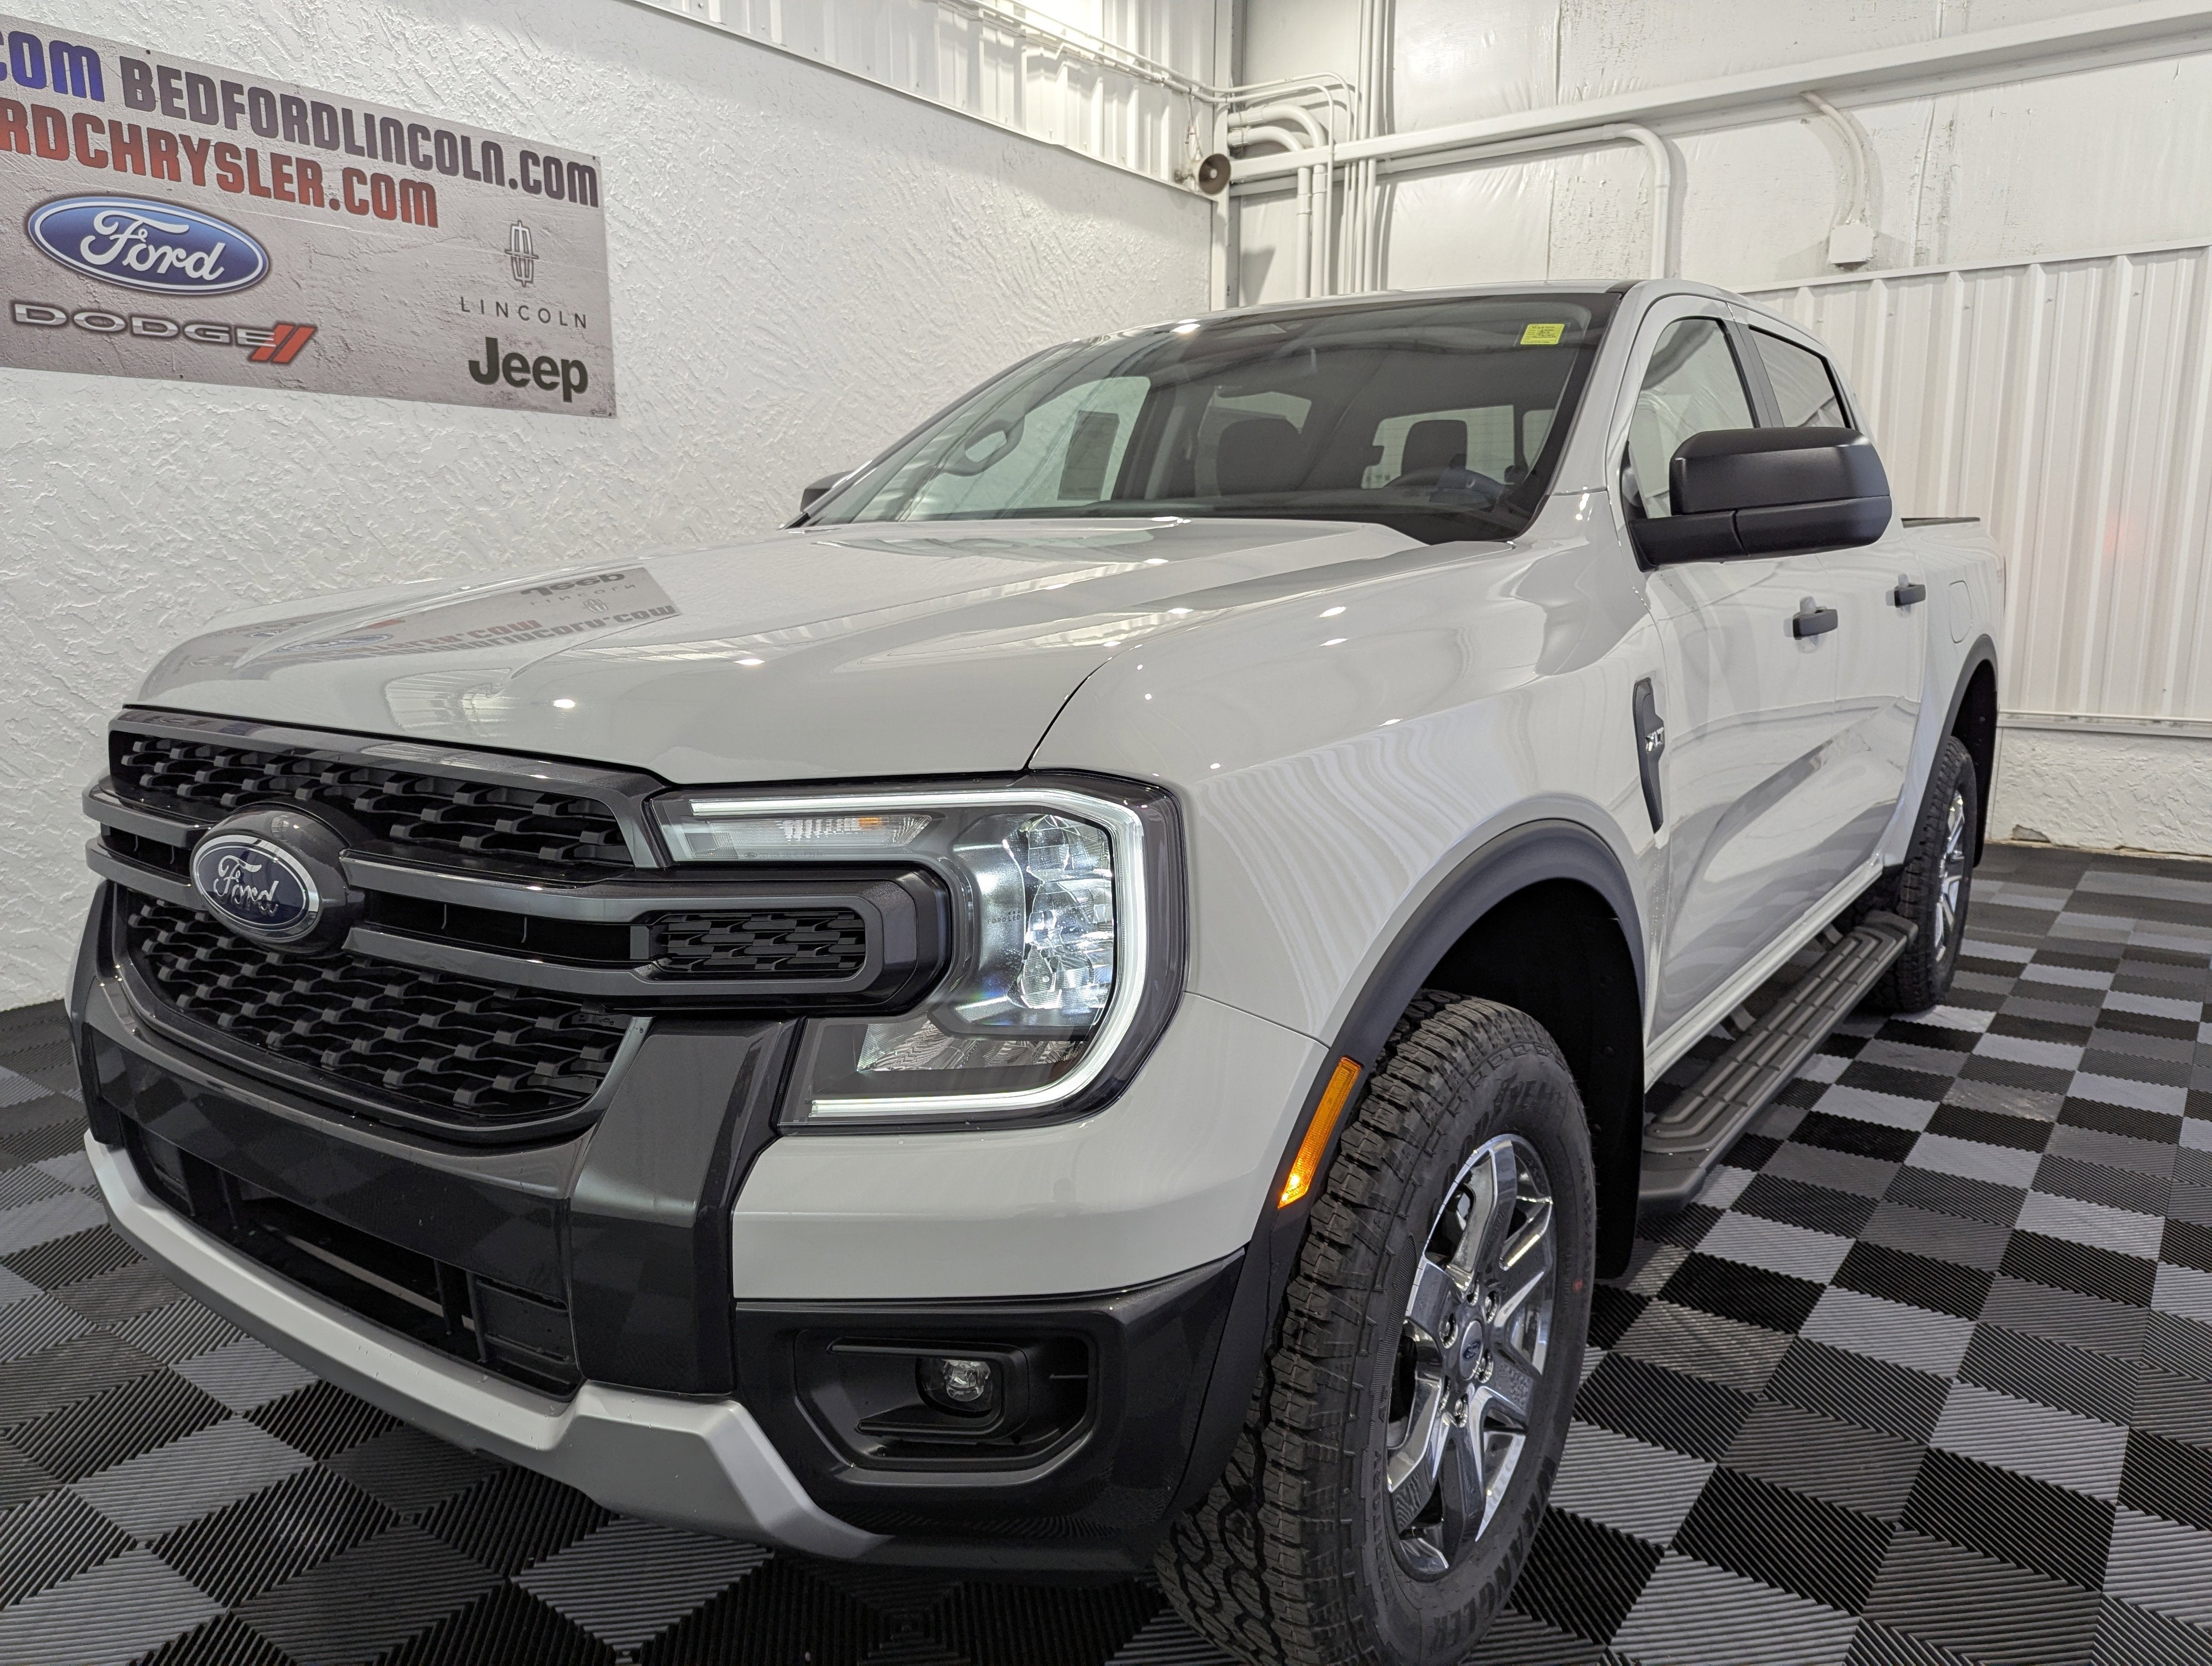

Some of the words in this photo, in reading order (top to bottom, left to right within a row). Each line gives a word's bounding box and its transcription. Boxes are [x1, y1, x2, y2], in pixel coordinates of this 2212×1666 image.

[0, 30, 105, 102] OM
[120, 55, 599, 208] BEDFORDLINCOLN.COM
[80, 210, 226, 280] Ford
[14, 303, 276, 348] DODGE
[461, 296, 587, 329] LINCOLN
[468, 337, 589, 403] Jeep
[214, 855, 279, 917] Ford
[1430, 1456, 1556, 1656] WRANGLER
